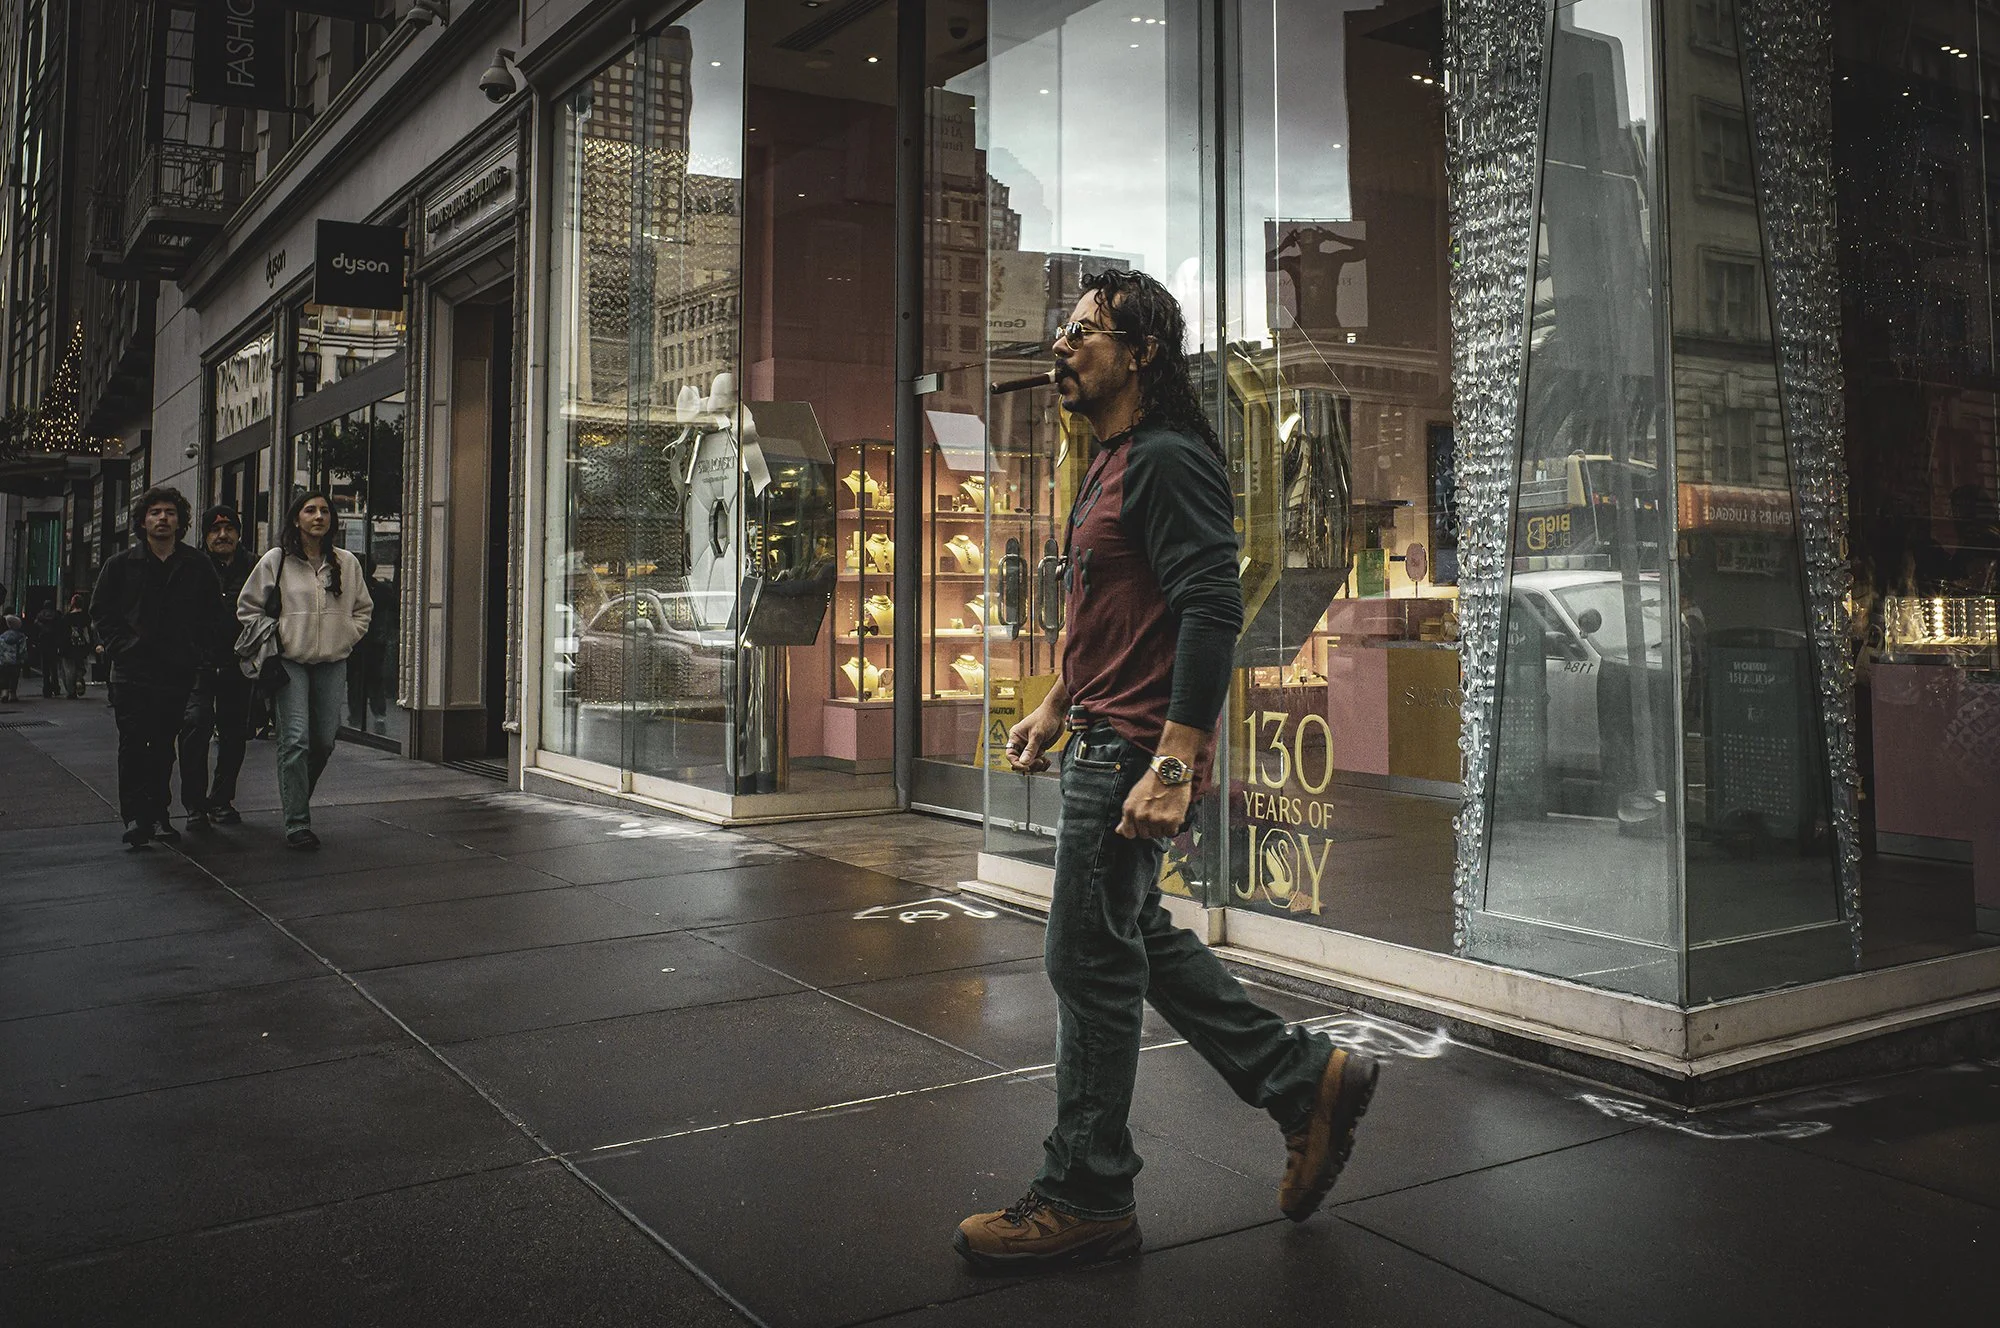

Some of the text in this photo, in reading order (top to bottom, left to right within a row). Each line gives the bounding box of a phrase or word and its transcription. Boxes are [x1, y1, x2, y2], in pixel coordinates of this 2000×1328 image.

[266, 249, 286, 289] dyson
[332, 252, 390, 275] dyson
[1243, 710, 1333, 795] 130
[1243, 790, 1334, 830] YEARS OF
